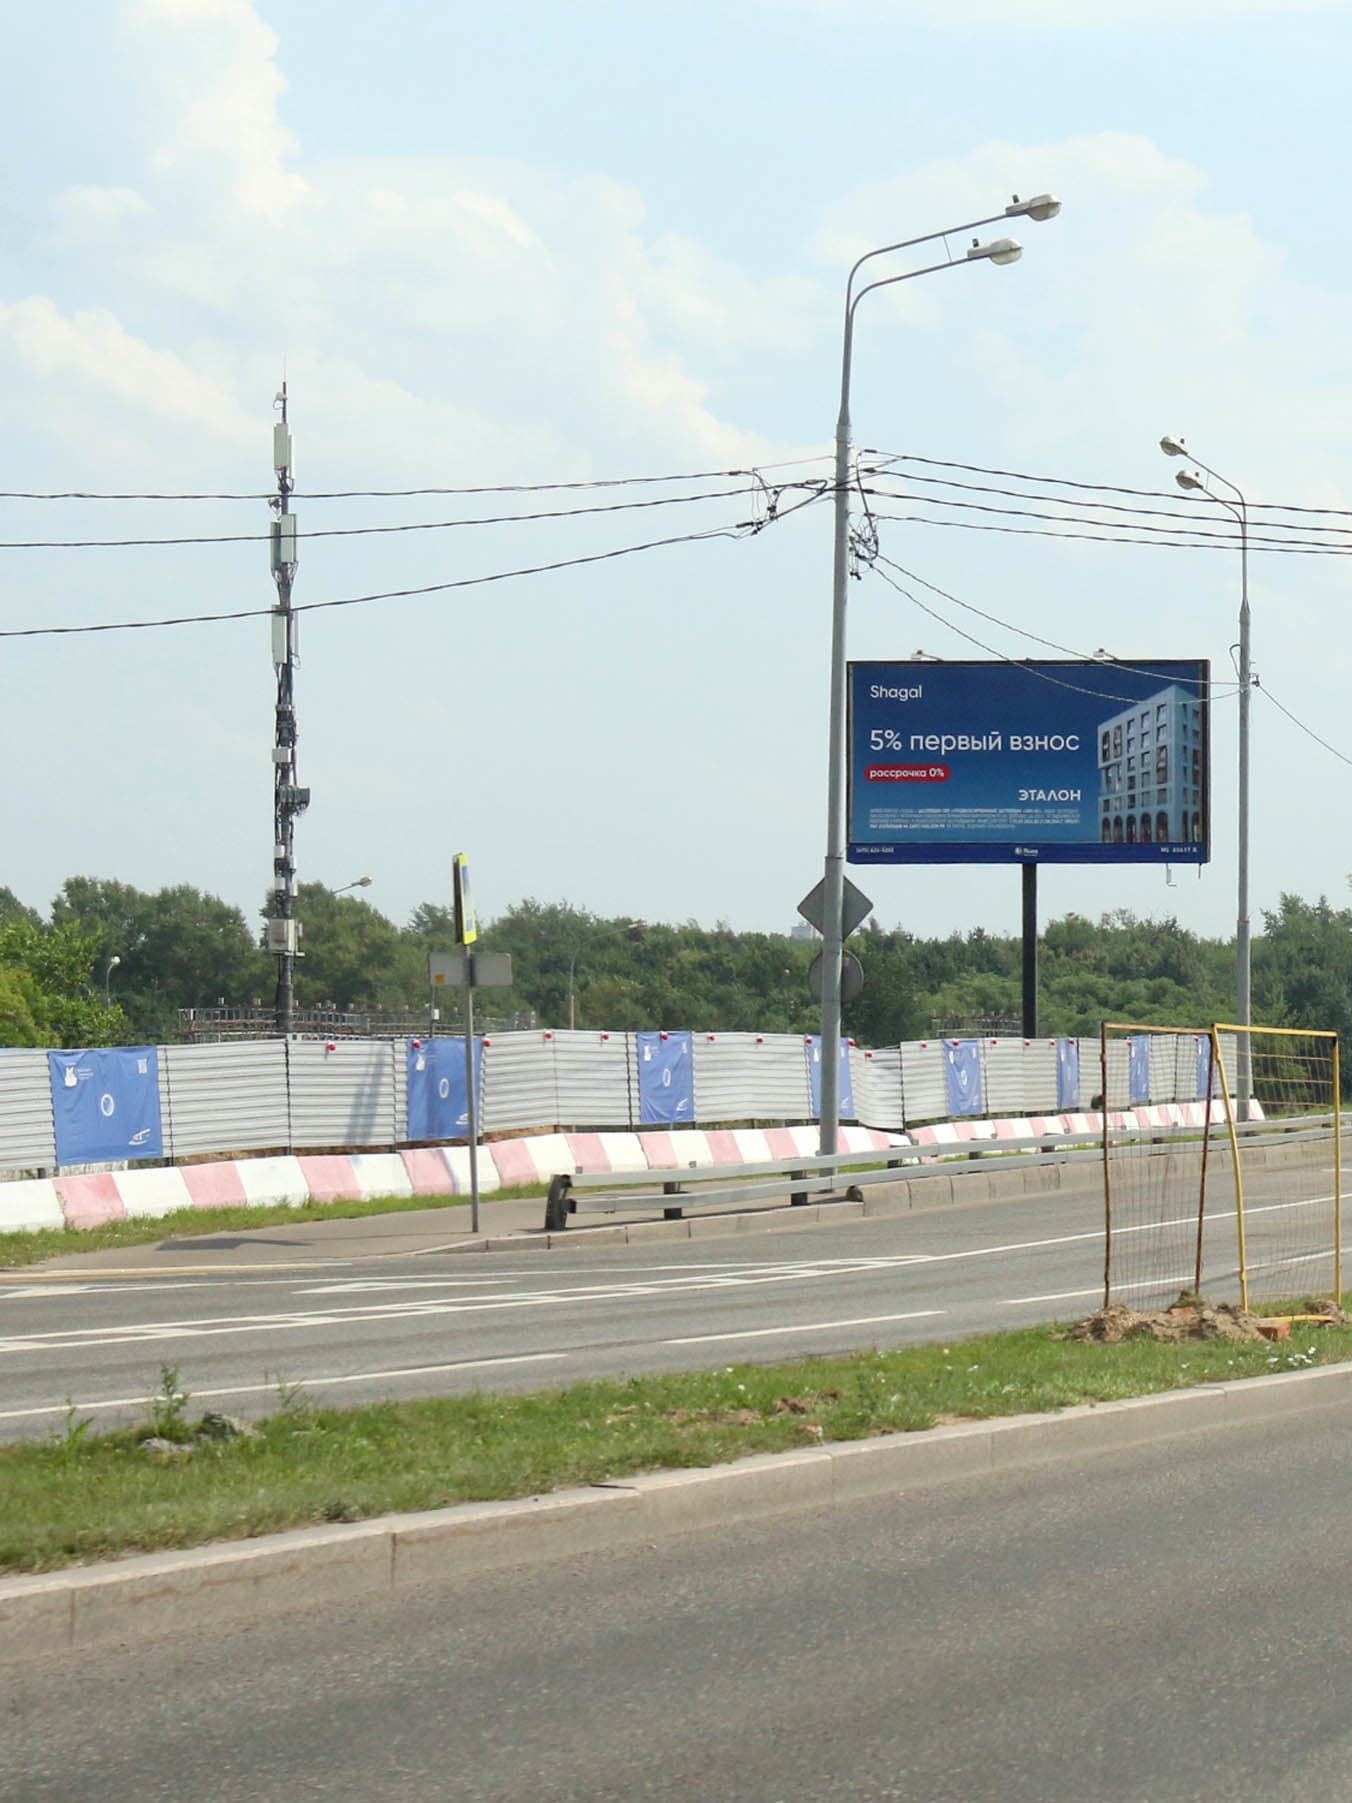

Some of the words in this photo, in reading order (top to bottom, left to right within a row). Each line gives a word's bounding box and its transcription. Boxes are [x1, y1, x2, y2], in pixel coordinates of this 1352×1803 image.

[870, 684, 923, 702] Shagal
[870, 729, 902, 752] 5%
[910, 730, 1002, 756] первый
[1009, 733, 1080, 752] взнос
[869, 769, 928, 781] рассрочка
[929, 767, 945, 778] 0%
[1018, 789, 1081, 802] ЭТАЛОН
